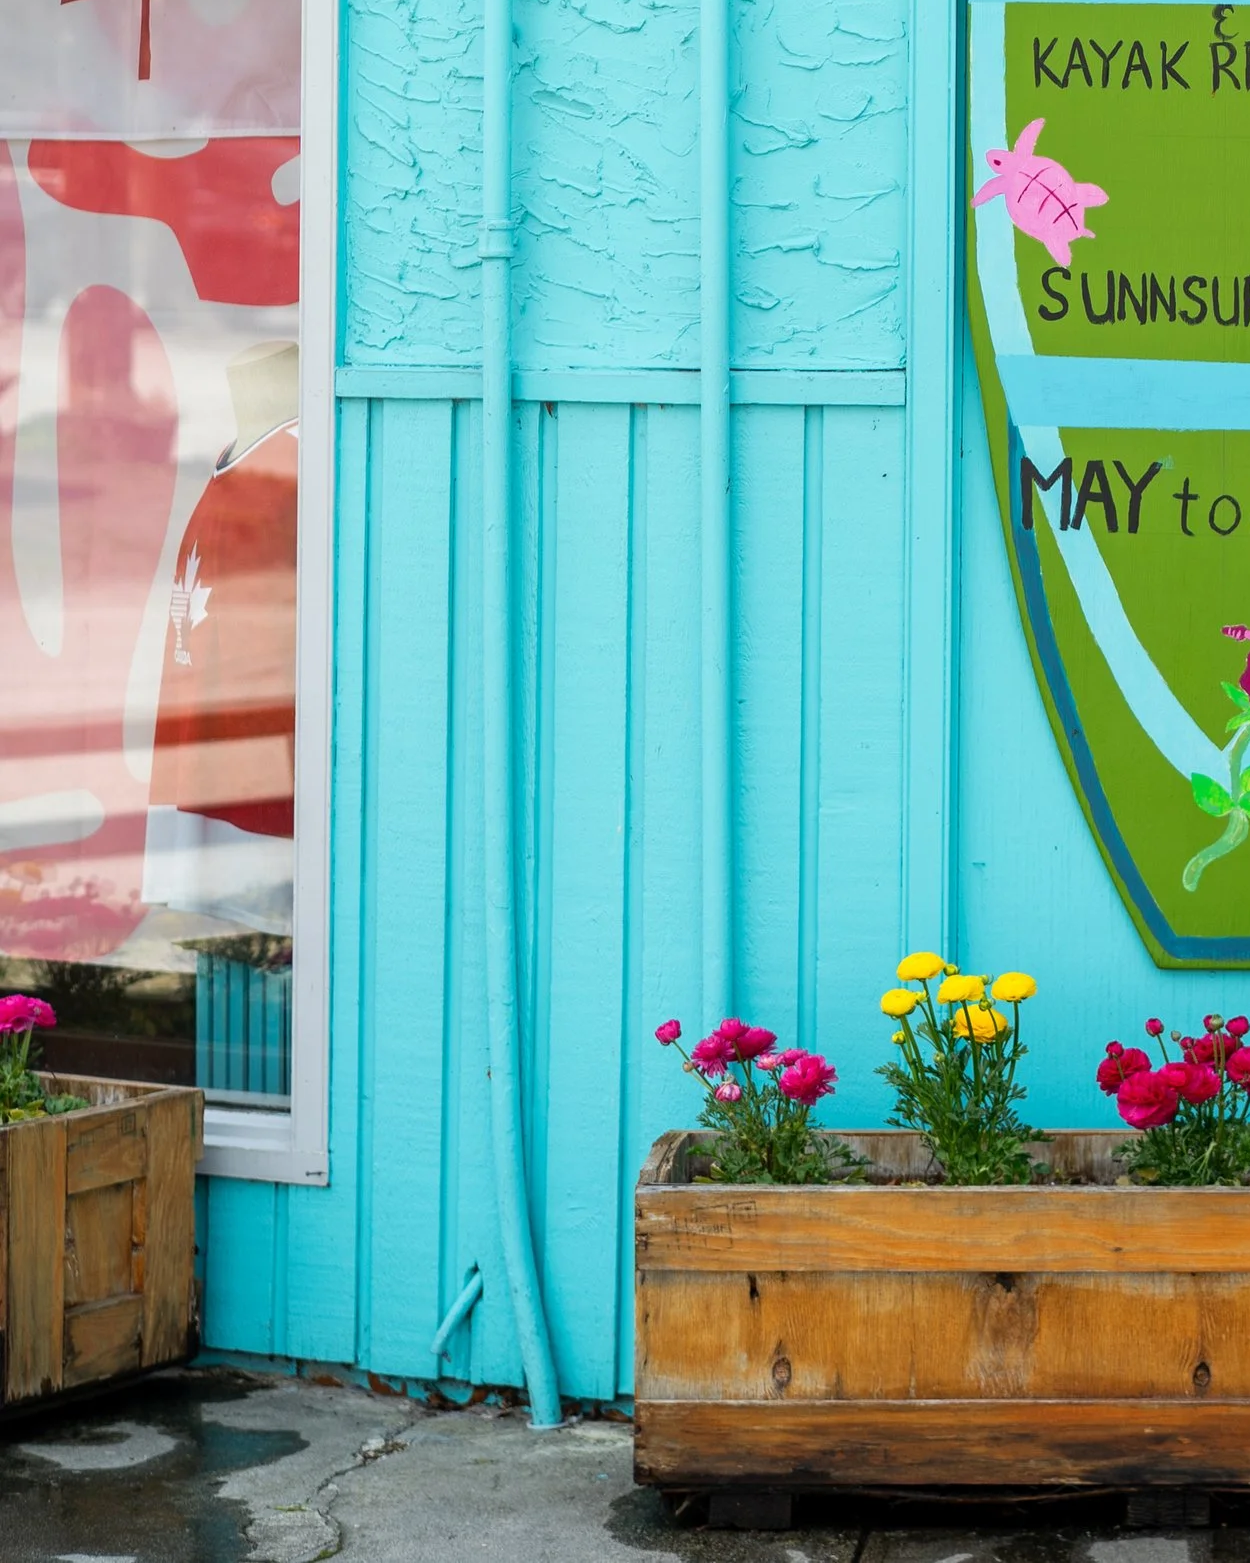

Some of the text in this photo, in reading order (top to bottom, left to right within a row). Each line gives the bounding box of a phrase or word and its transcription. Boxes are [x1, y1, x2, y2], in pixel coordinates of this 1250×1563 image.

[1033, 37, 1191, 91] KAYAK
[1019, 455, 1162, 534] MAY
[1173, 477, 1242, 536] to
